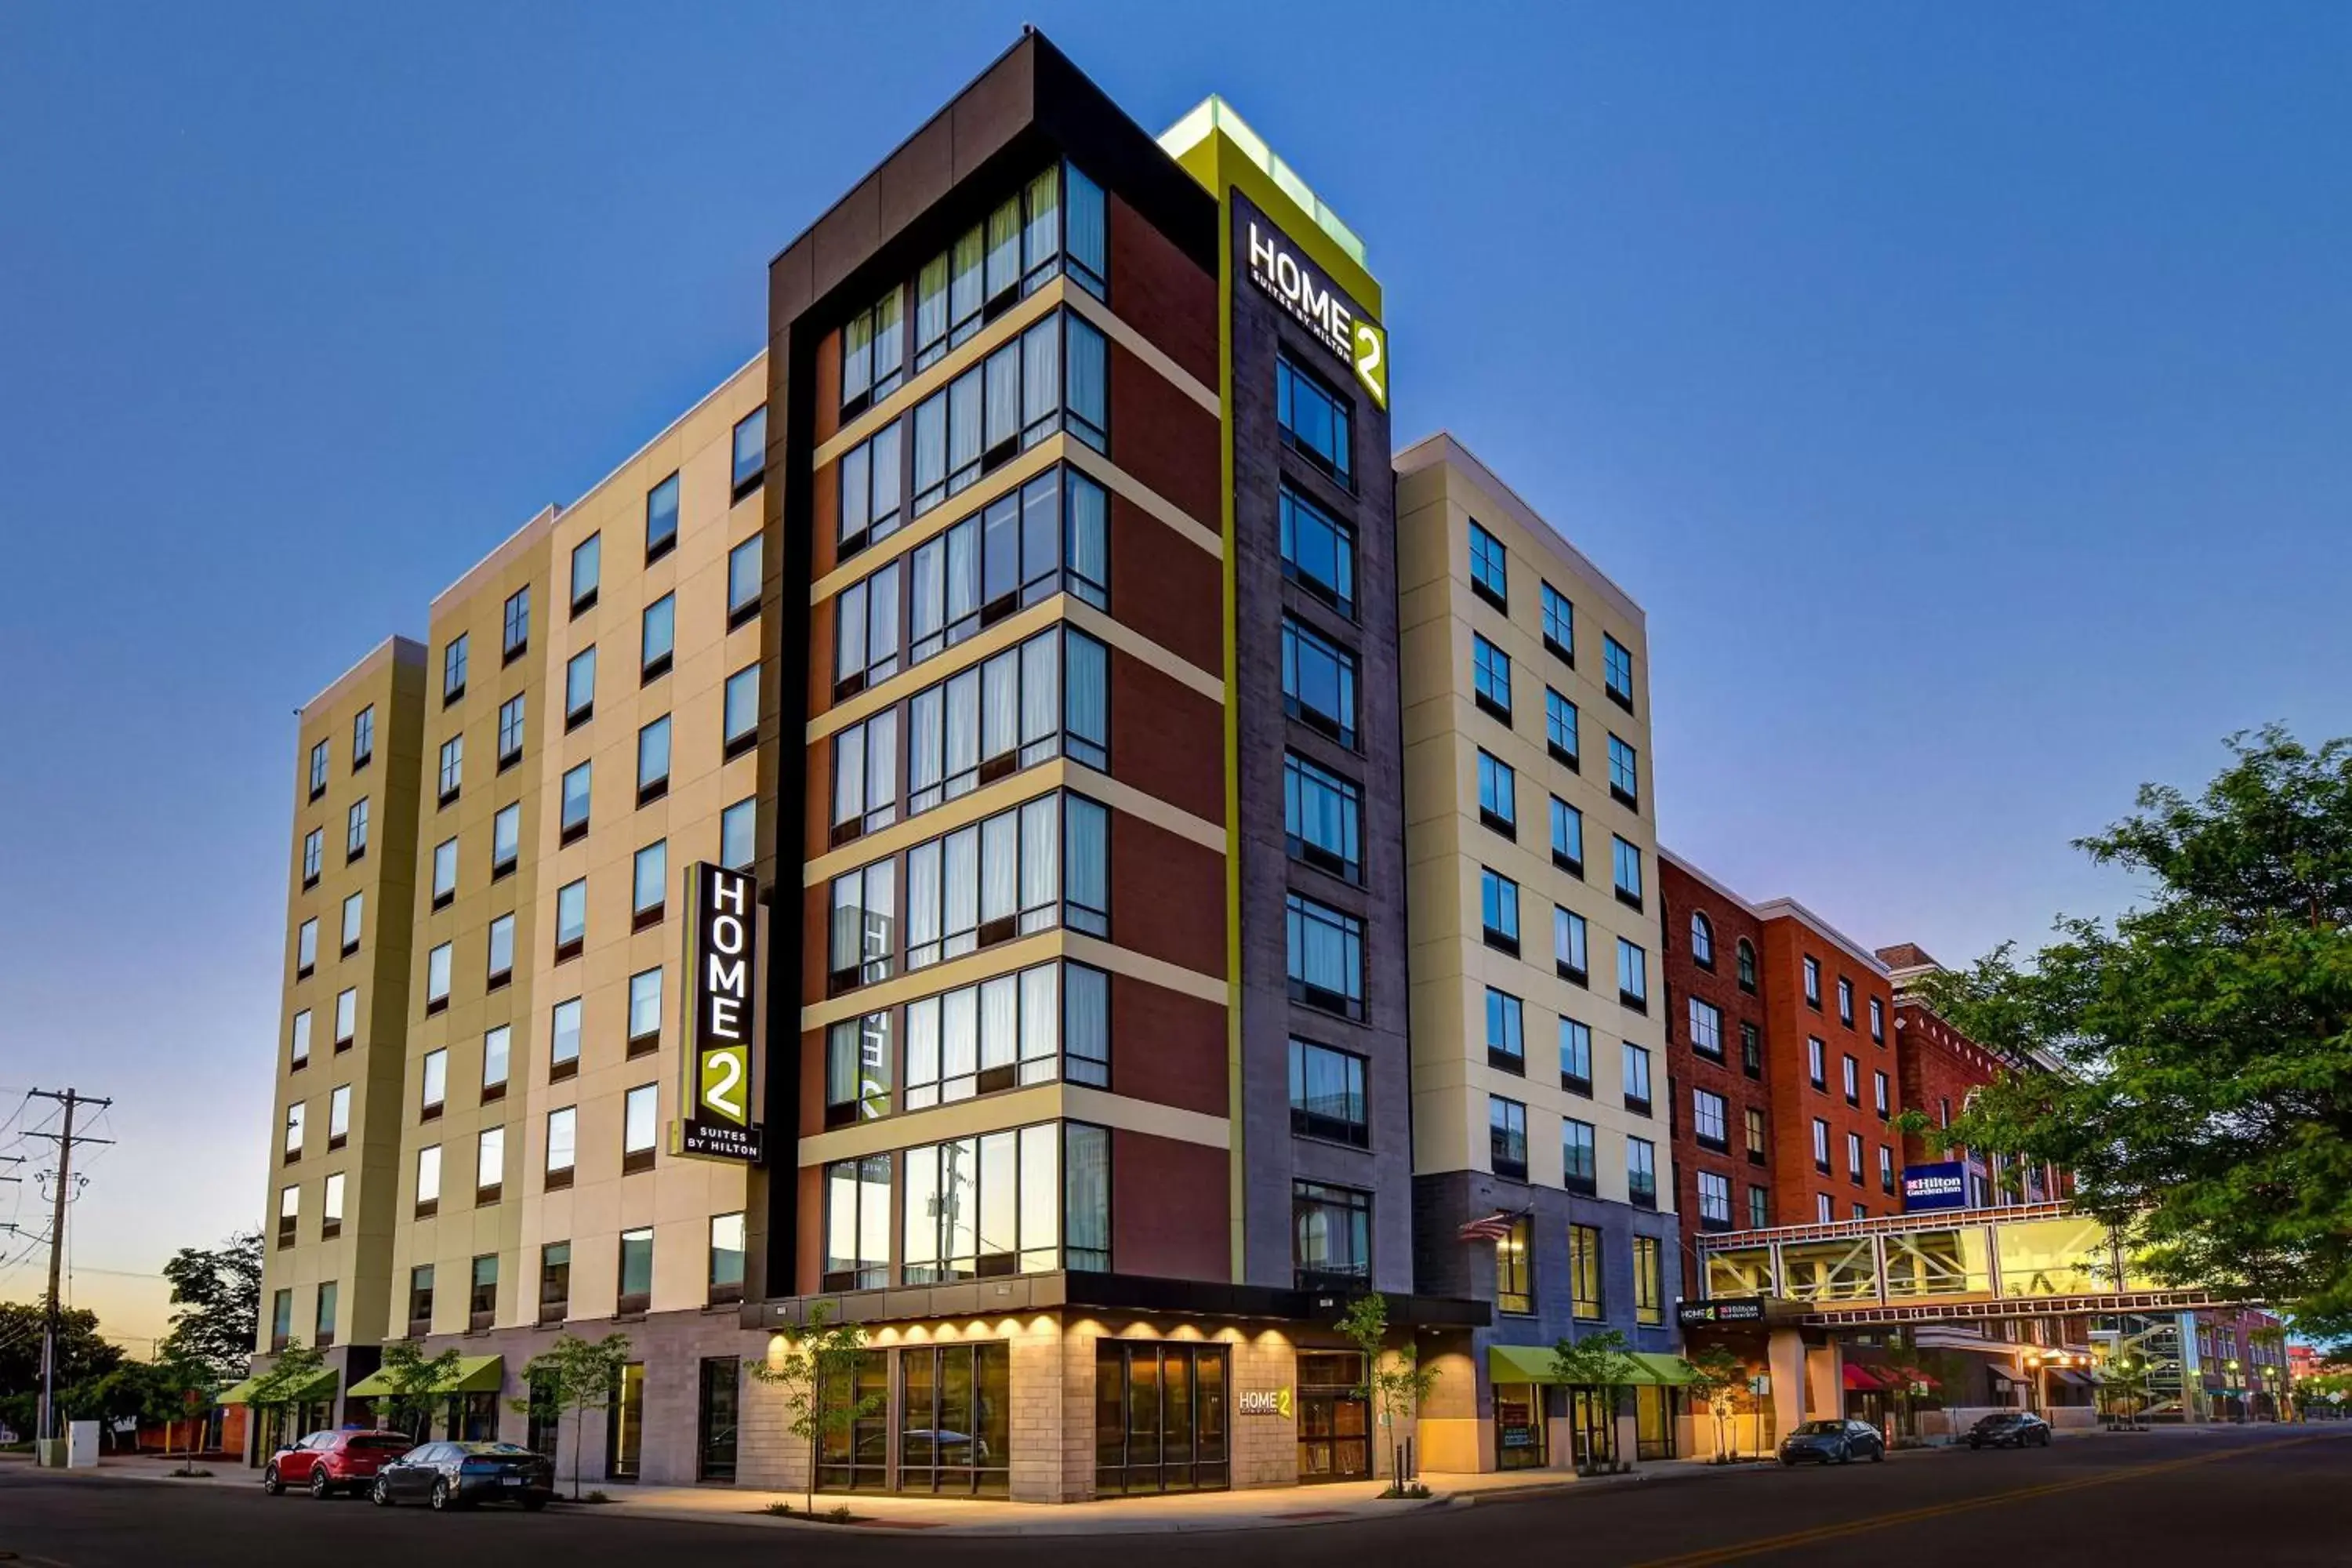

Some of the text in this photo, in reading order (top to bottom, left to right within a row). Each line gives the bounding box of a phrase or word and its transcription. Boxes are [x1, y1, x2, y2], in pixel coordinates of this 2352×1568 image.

[1250, 222, 1383, 401] HOME 2
[1313, 324, 1351, 363] HILTON
[706, 871, 746, 1118] HOME 2
[688, 1138, 757, 1156] BY HILTON
[700, 1127, 746, 1142] SUITES
[1918, 1177, 1961, 1189] Hilton
[1240, 1390, 1291, 1419] HOME 2
